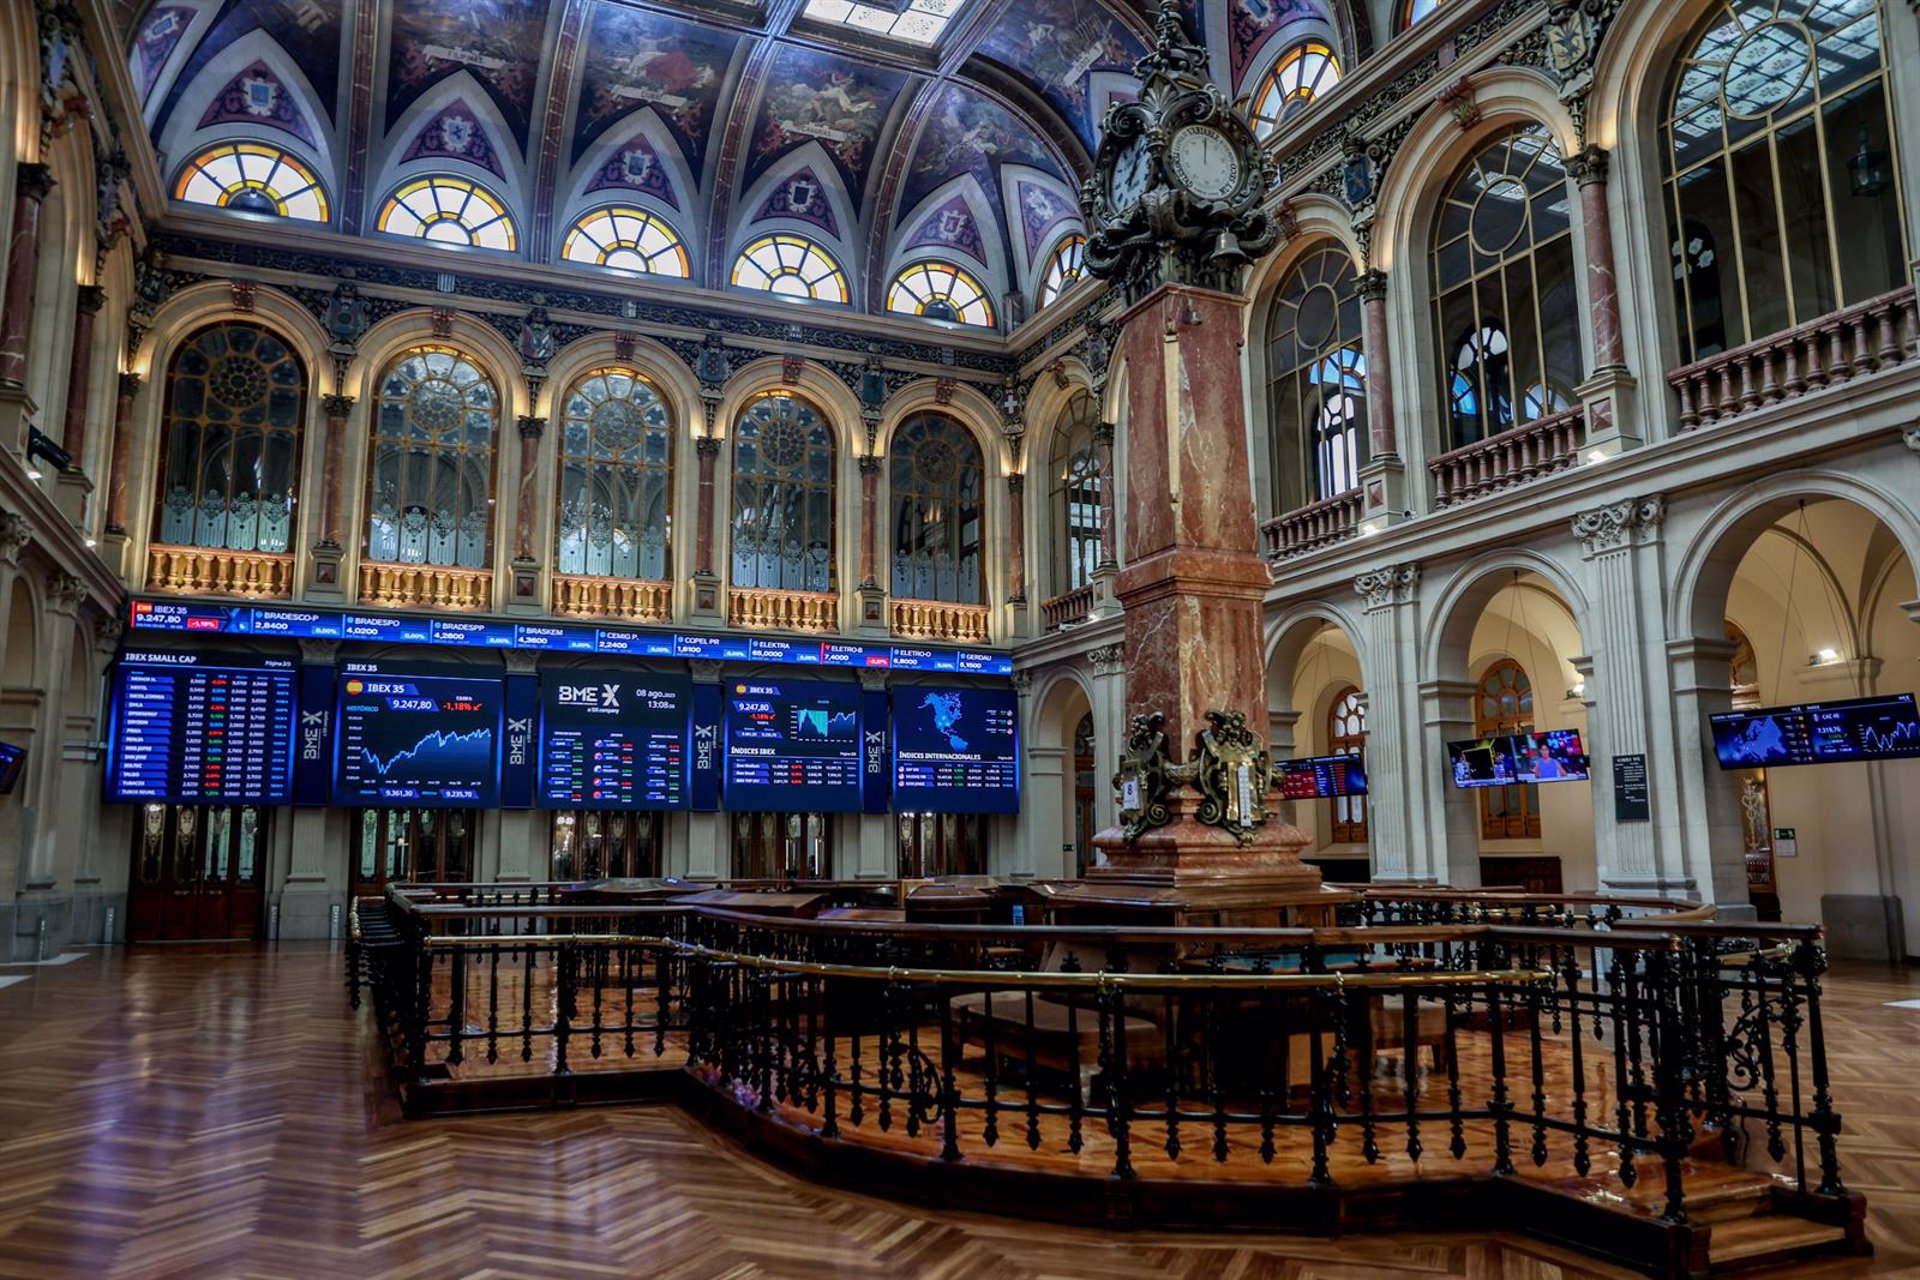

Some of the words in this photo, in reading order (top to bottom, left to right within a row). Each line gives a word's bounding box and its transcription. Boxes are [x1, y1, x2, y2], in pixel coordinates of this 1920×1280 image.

[154, 605, 175, 614] IBEX
[264, 612, 319, 621] BRADESCO-P
[526, 627, 563, 636] BRASKEM
[125, 653, 146, 662] IBEX
[148, 654, 177, 663] SMALL
[179, 655, 196, 663] CAP
[347, 663, 366, 671] IBEX
[368, 684, 391, 693] IBEX
[393, 684, 404, 693] 35
[559, 686, 598, 702] BME
[393, 700, 432, 710] 9.247,80
[443, 702, 471, 711] -1,18%
[303, 728, 318, 759] BME
[510, 734, 522, 765] BME
[698, 741, 709, 769] BME
[868, 746, 878, 773] BME
